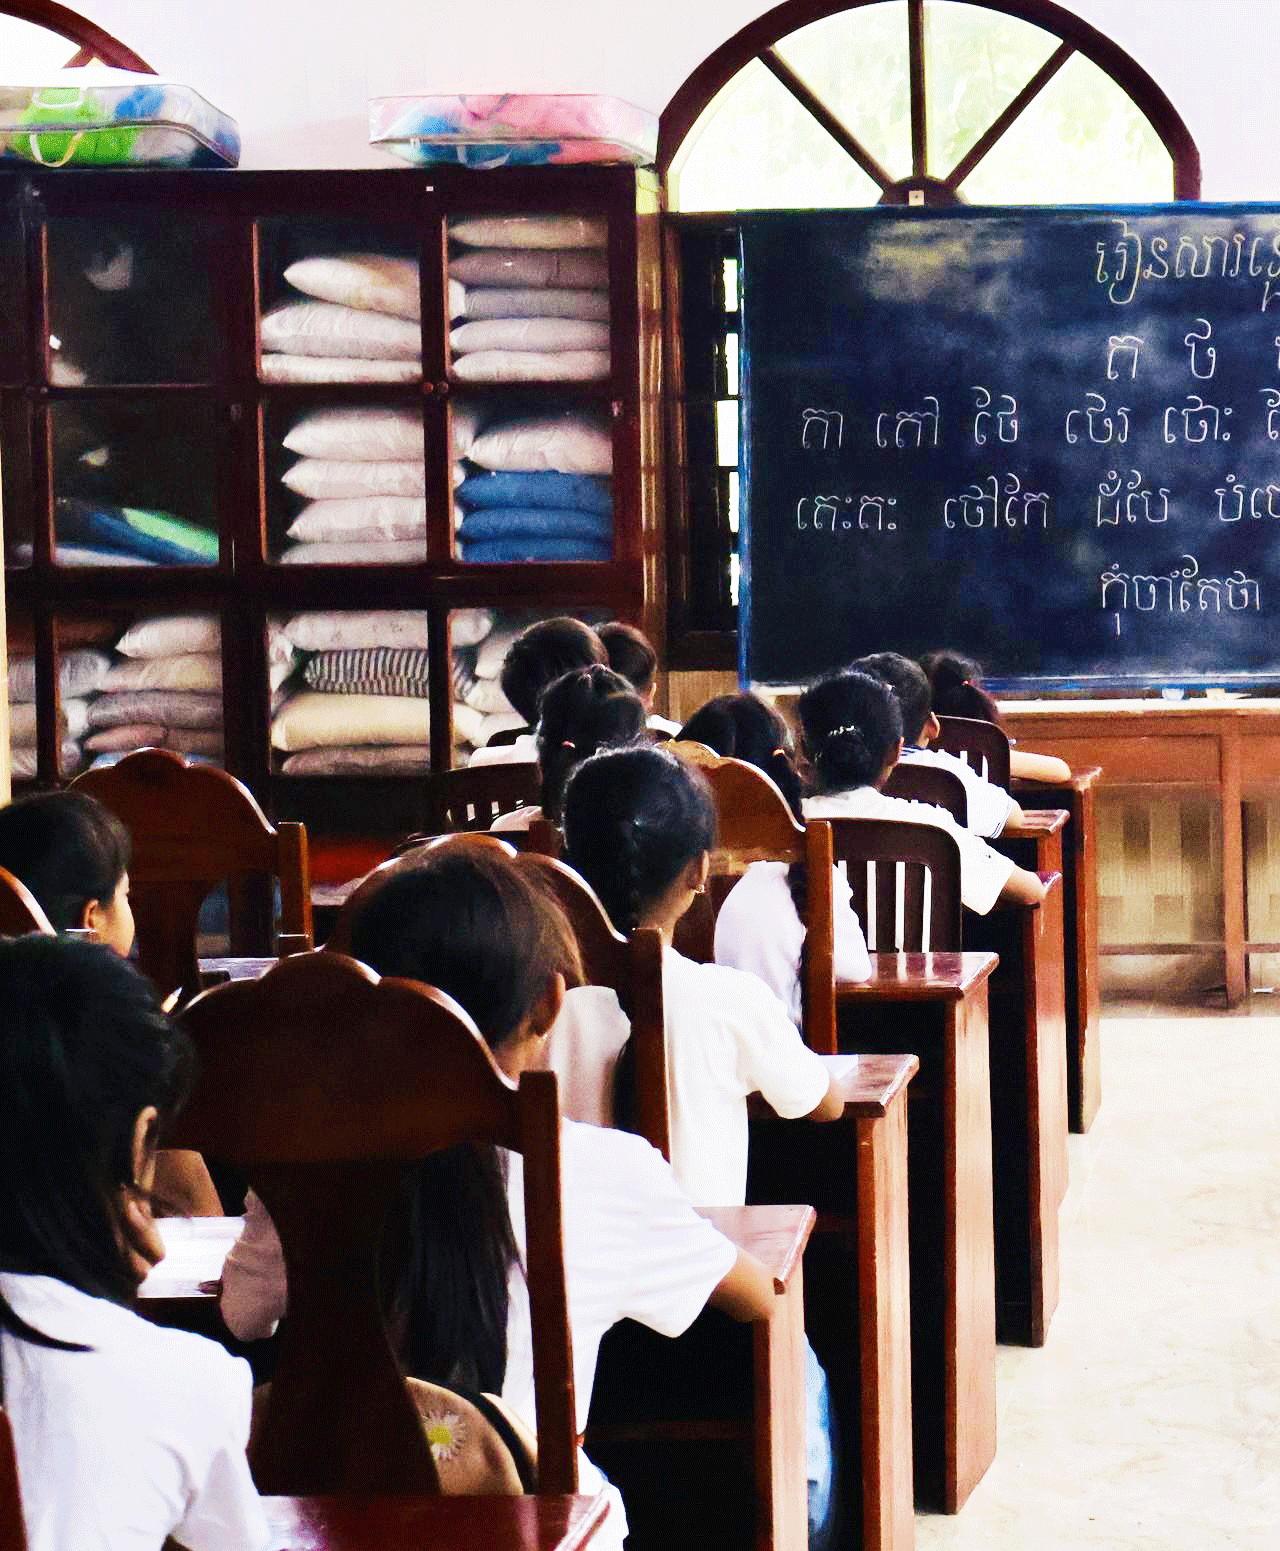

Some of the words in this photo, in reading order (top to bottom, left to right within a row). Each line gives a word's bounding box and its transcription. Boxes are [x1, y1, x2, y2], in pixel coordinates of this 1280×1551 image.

[1107, 335, 1144, 380] ត
[1184, 318, 1216, 379] ថ
[802, 408, 844, 449] តា
[876, 395, 940, 448] តៅ
[1066, 392, 1131, 443] ថេរ
[1163, 395, 1233, 443] ថោះ
